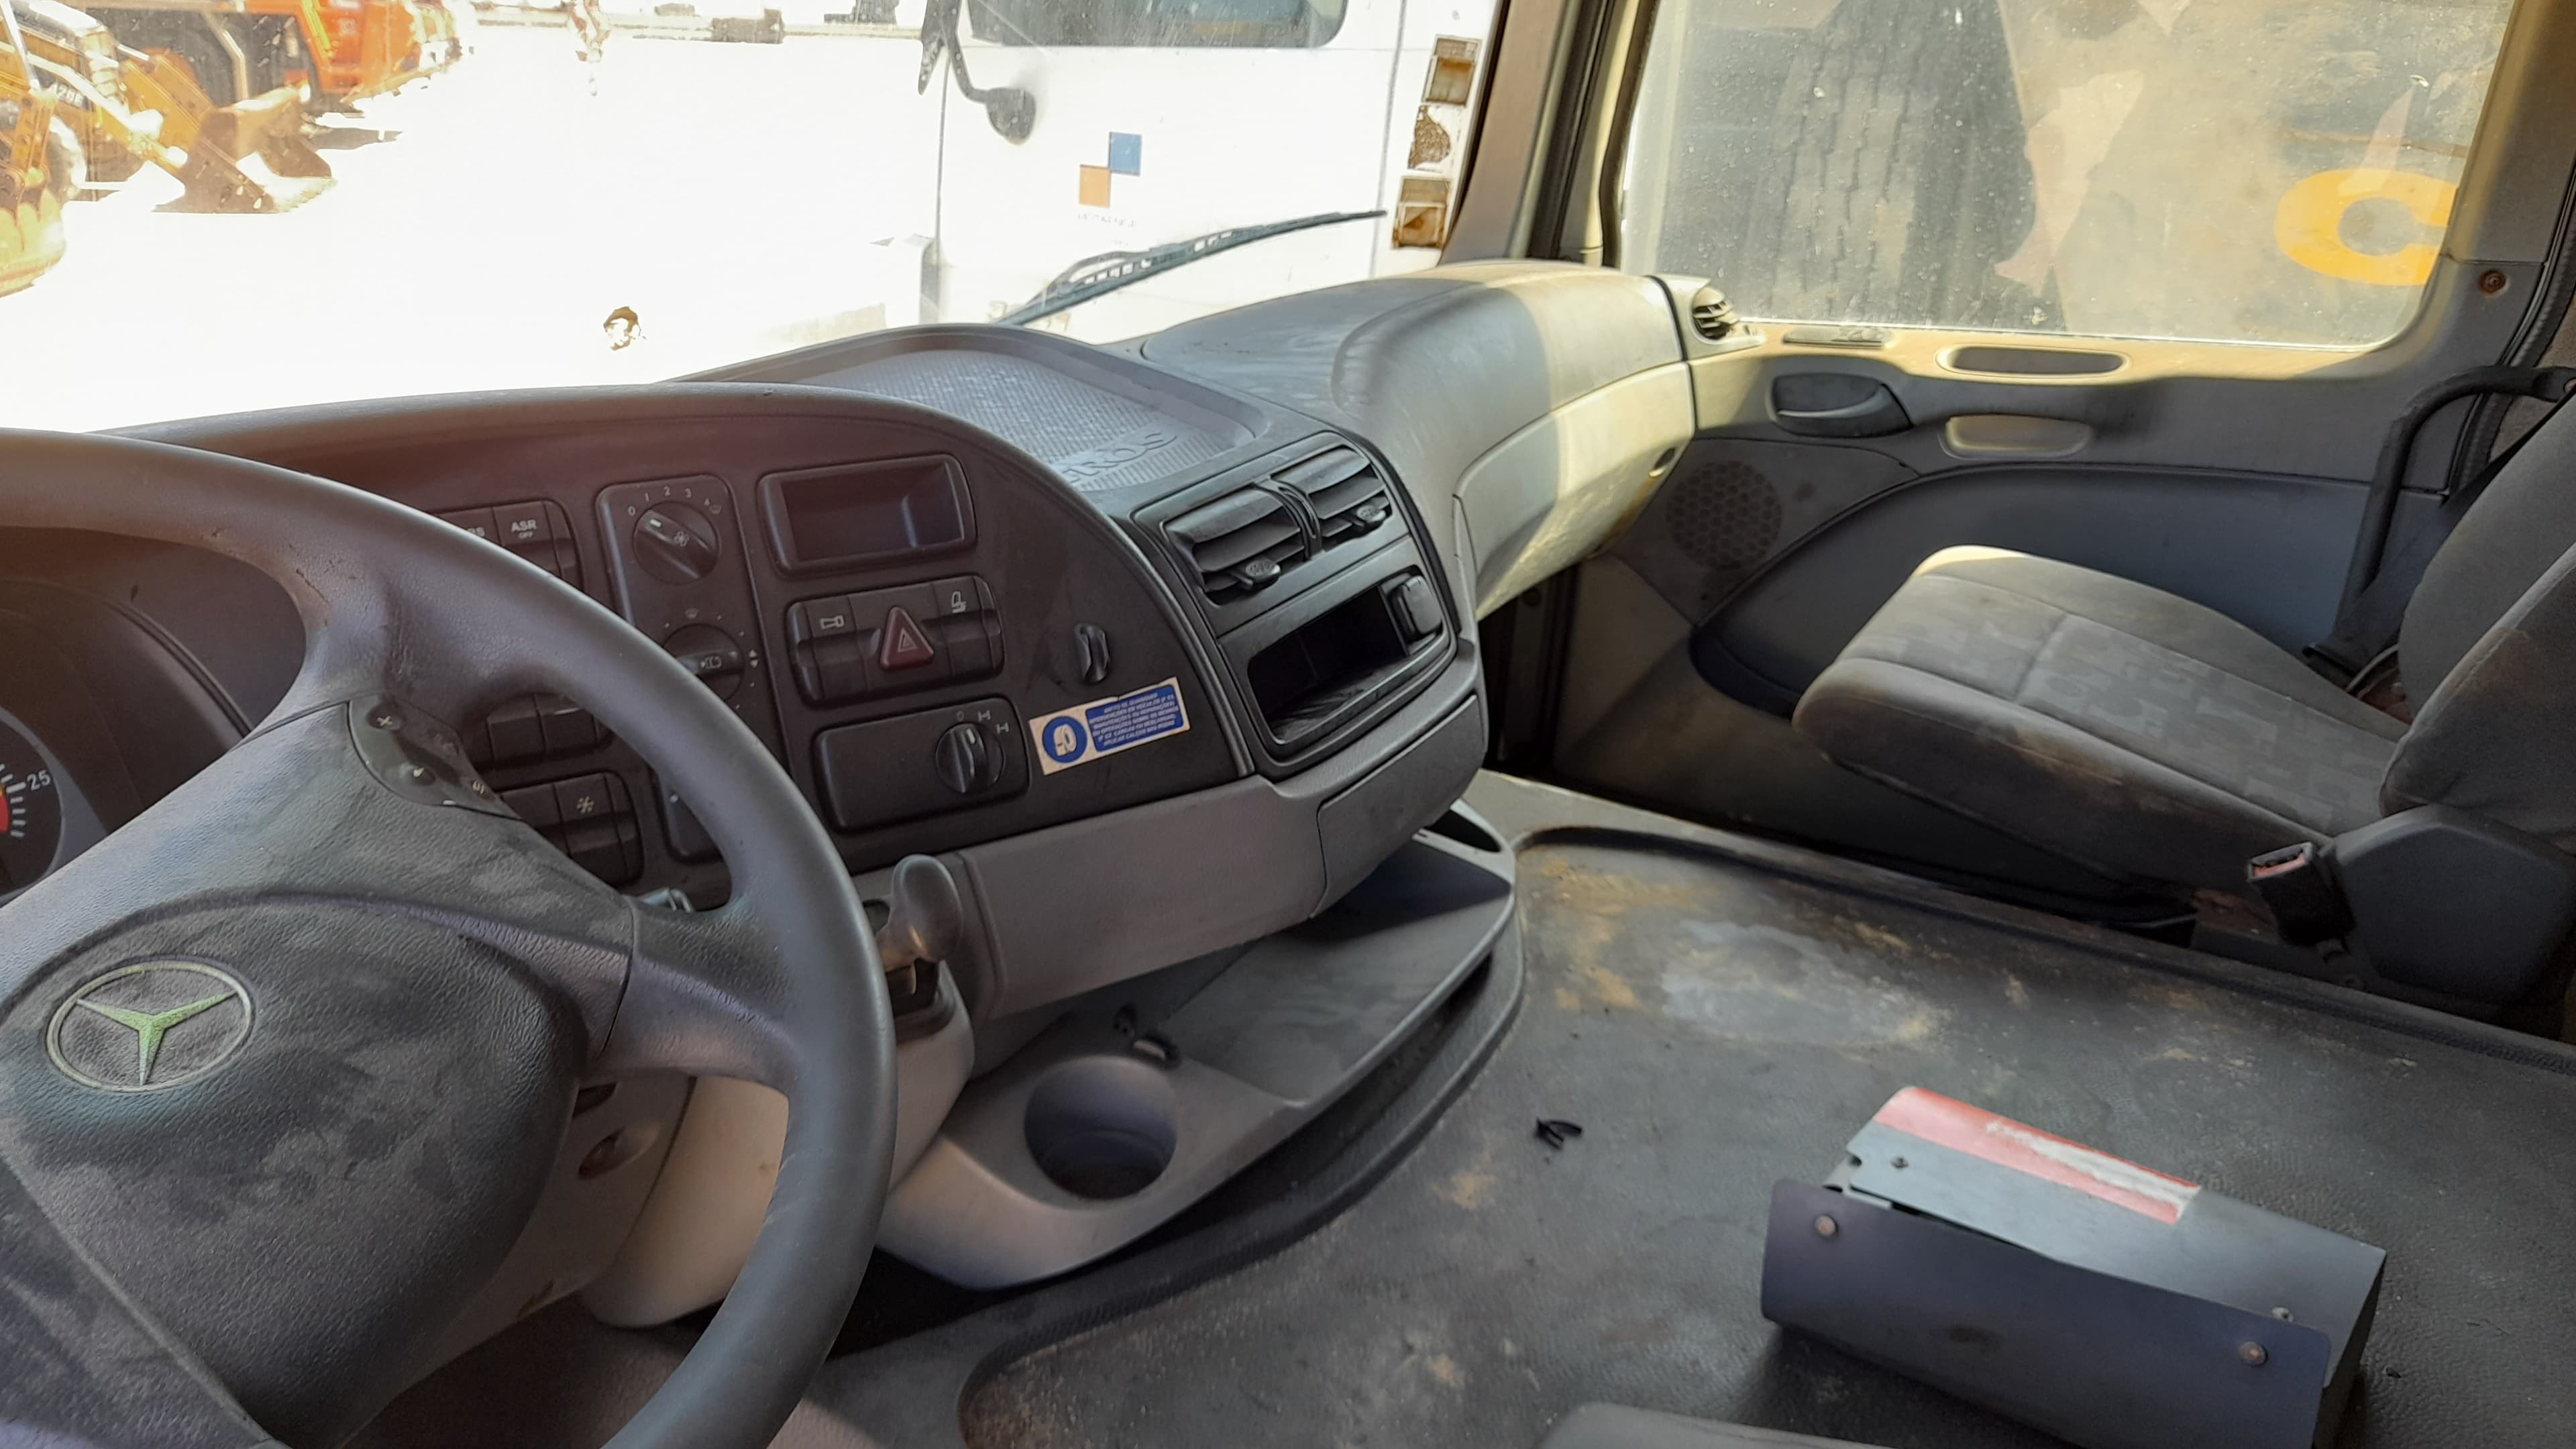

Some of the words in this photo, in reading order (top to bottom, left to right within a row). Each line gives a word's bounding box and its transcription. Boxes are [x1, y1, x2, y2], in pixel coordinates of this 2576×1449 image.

[628, 505, 636, 516] 0
[664, 485, 671, 496] 2
[685, 488, 692, 498] 3
[511, 519, 537, 533] ASR
[27, 769, 51, 790] 25
